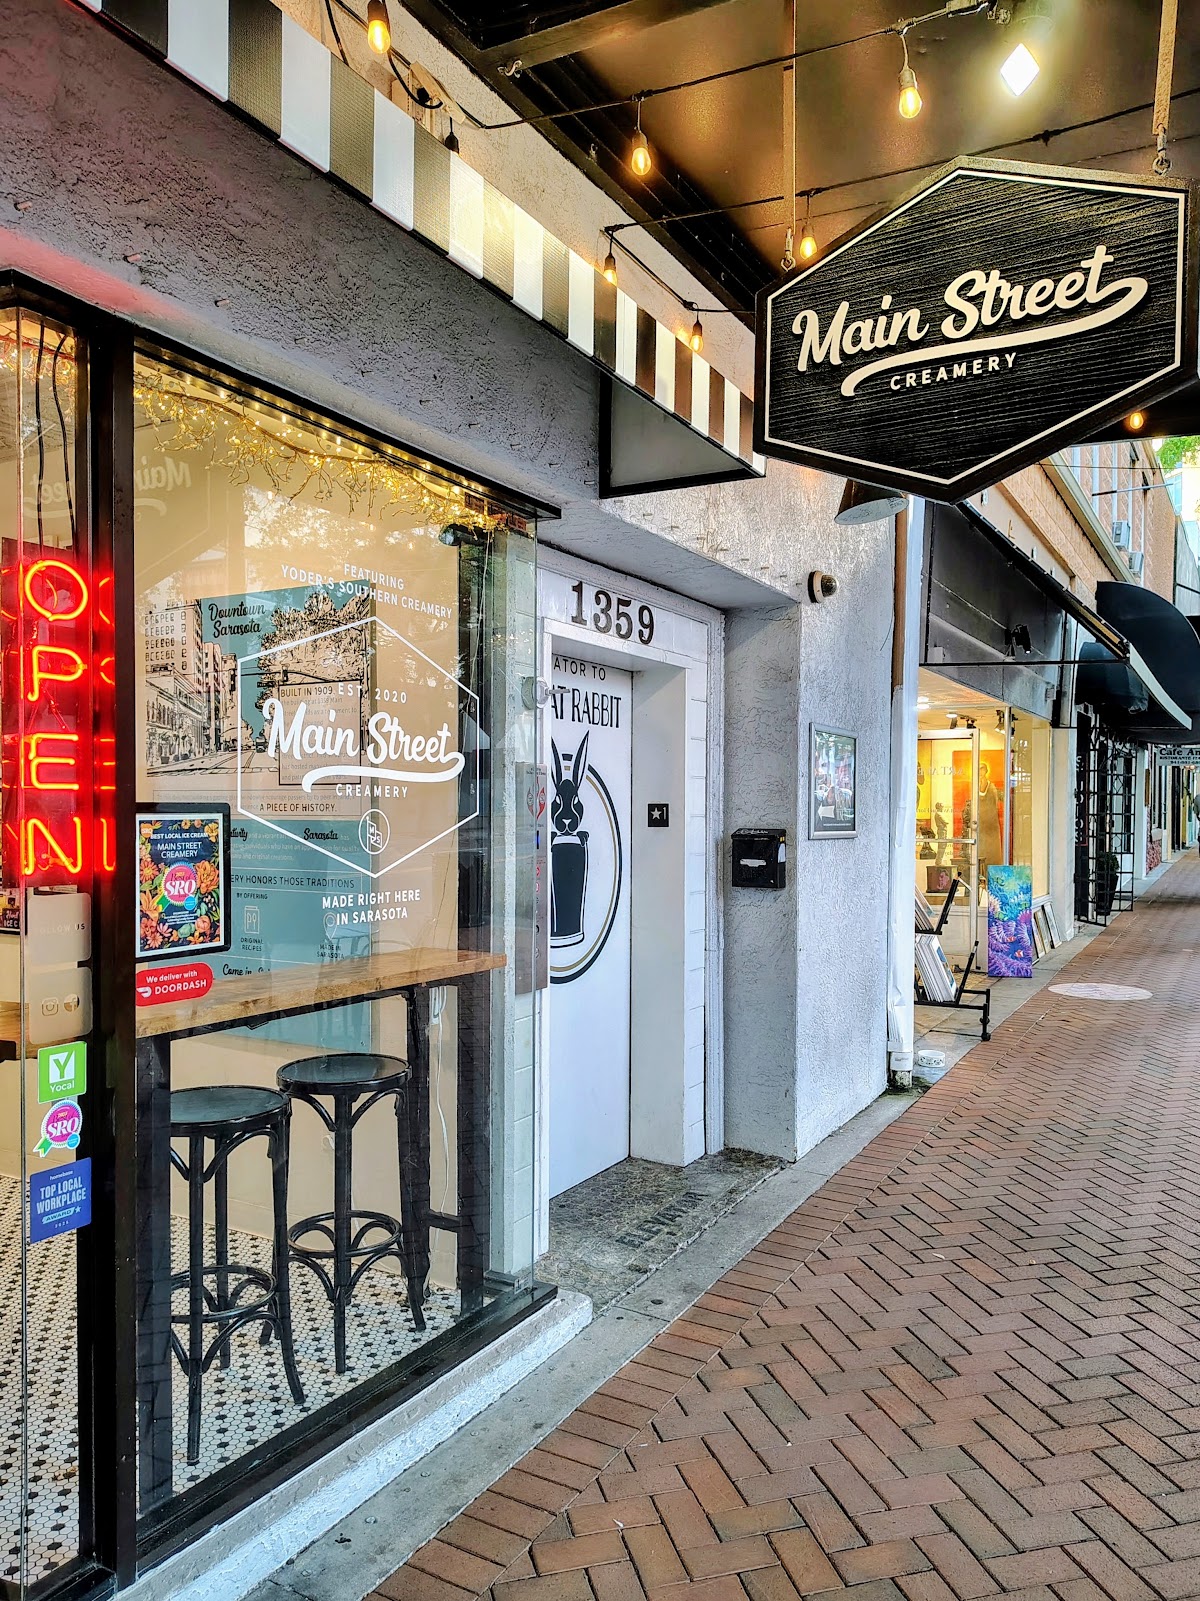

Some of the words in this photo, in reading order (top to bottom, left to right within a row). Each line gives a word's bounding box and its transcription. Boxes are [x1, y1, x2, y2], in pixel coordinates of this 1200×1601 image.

[792, 294, 930, 371] Main
[940, 245, 1130, 339] Street
[890, 352, 1017, 391] CREAMERY
[344, 564, 404, 590] FEATURING
[281, 565, 335, 589] YODER'S
[339, 580, 398, 606] SOUTHERN
[401, 597, 453, 619] CREAMERY
[208, 601, 266, 621] Downtown
[571, 580, 655, 645] 1359
[213, 621, 261, 638] Sarasota
[592, 666, 606, 681] TO
[280, 688, 302, 698] BUILT
[304, 687, 312, 696] IN
[338, 683, 362, 698] EST
[375, 688, 407, 704] 2020
[571, 688, 621, 728] RABBIT
[24, 559, 88, 875] OPEN
[262, 697, 361, 760] Main
[366, 711, 458, 764] Street
[336, 784, 408, 798] CREAMERY
[259, 803, 265, 811] A
[267, 803, 288, 812] PIECE
[289, 803, 300, 812] OF
[662, 806, 667, 820] 1
[303, 828, 339, 841] Sarasota
[157, 843, 177, 851] MAIN
[177, 842, 202, 850] STREET
[161, 850, 198, 859] CREAMERY
[165, 880, 196, 896] SRQ
[231, 874, 244, 883] ERY
[245, 875, 278, 885] HONORS
[280, 877, 304, 886] THOSE
[307, 878, 355, 888] TRADITIONS
[322, 895, 354, 909] MADE
[358, 891, 391, 906] RIGHT
[394, 889, 421, 903] HERE
[336, 913, 348, 925] IN
[353, 907, 408, 924] SARASOTA
[242, 944, 262, 952] RECIPES
[146, 975, 158, 983] We
[160, 973, 182, 982] deliver
[183, 970, 198, 979] with
[154, 979, 207, 995] DOORDASH
[50, 1080, 75, 1093] Yocal
[49, 1170, 73, 1180] homebase
[40, 1184, 57, 1199] TOP
[58, 1176, 83, 1195] LOCAL
[36, 1187, 87, 1215] WORKPLACE
[46, 1209, 72, 1222] AWARD
